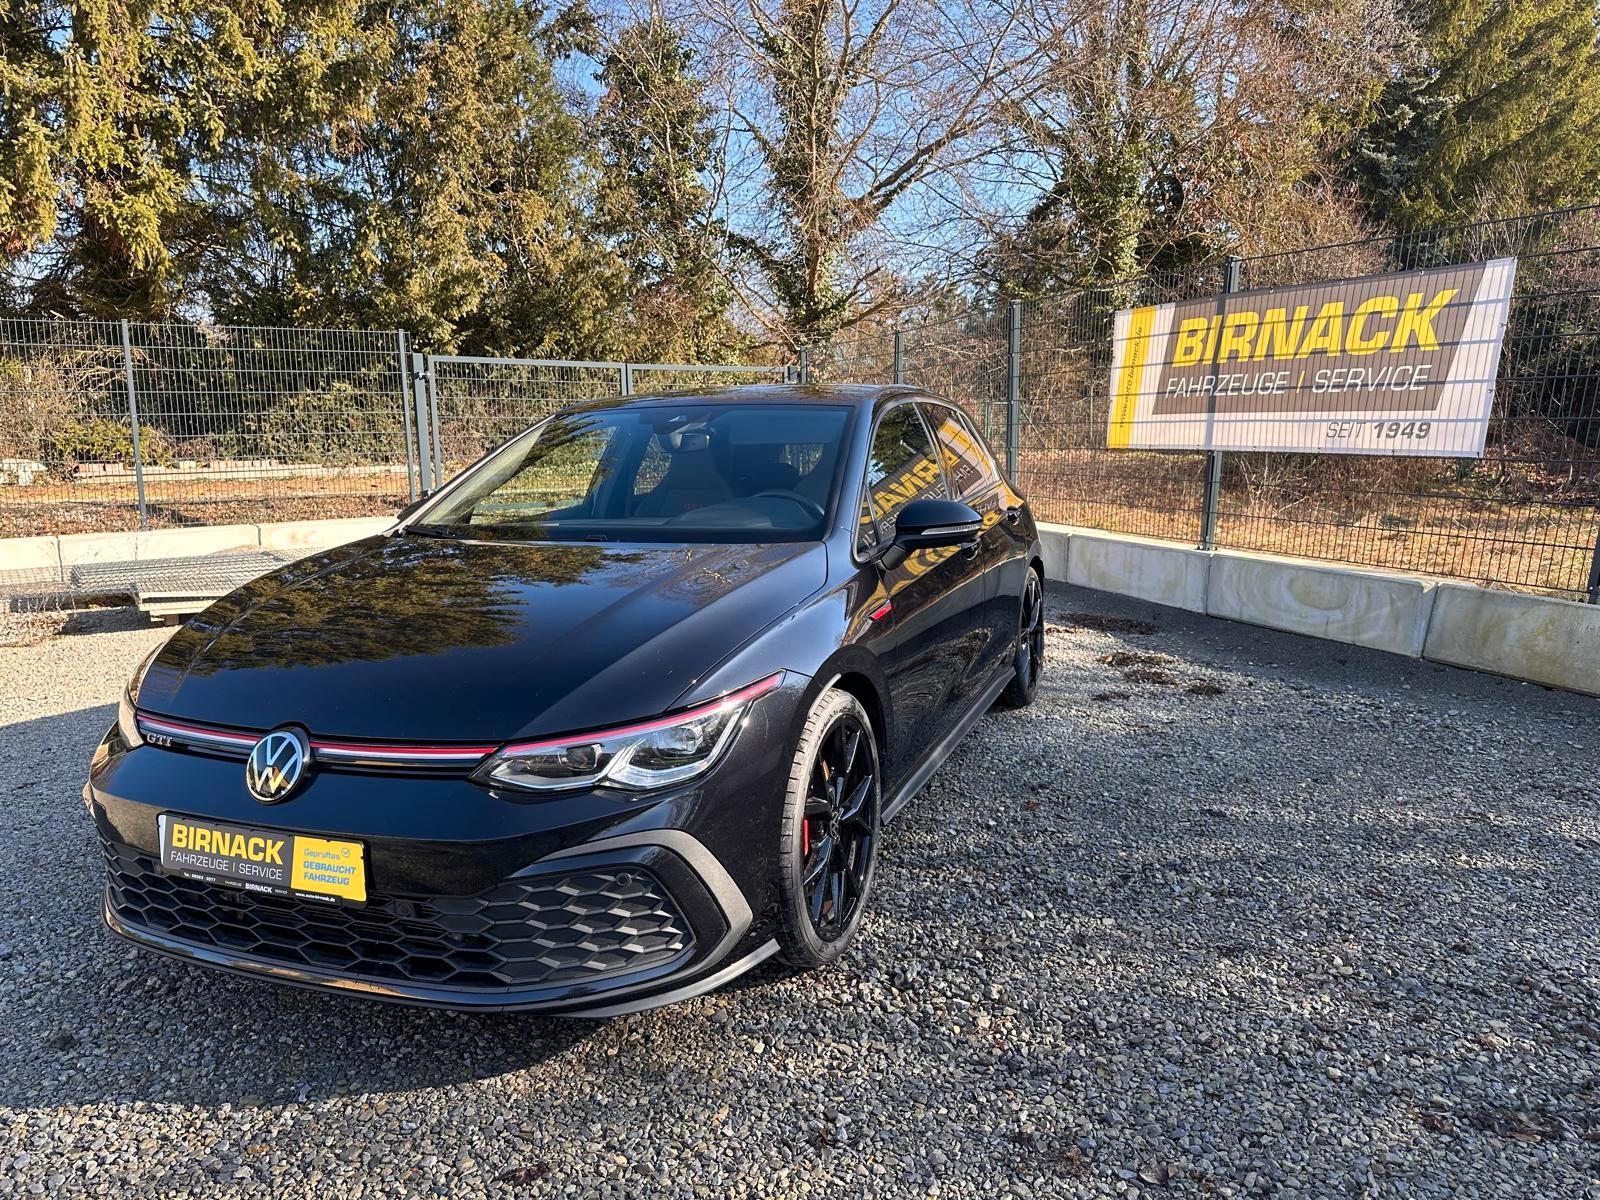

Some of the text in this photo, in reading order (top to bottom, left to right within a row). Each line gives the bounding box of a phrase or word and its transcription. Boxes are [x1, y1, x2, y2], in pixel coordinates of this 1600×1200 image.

[1172, 288, 1460, 368] BIRNACK
[1165, 364, 1433, 399] FAHRZEUGE SERVICE
[1326, 421, 1431, 440] SEIT 1949
[146, 732, 173, 747] GTI
[171, 823, 285, 866] BIRNACK
[170, 850, 229, 872] FAHRZEUGE
[238, 863, 283, 881] SERVICE
[303, 860, 357, 876] GEBRAUCHT
[303, 871, 351, 886] FAHRZEUG
[245, 882, 273, 895] BIRNACK
